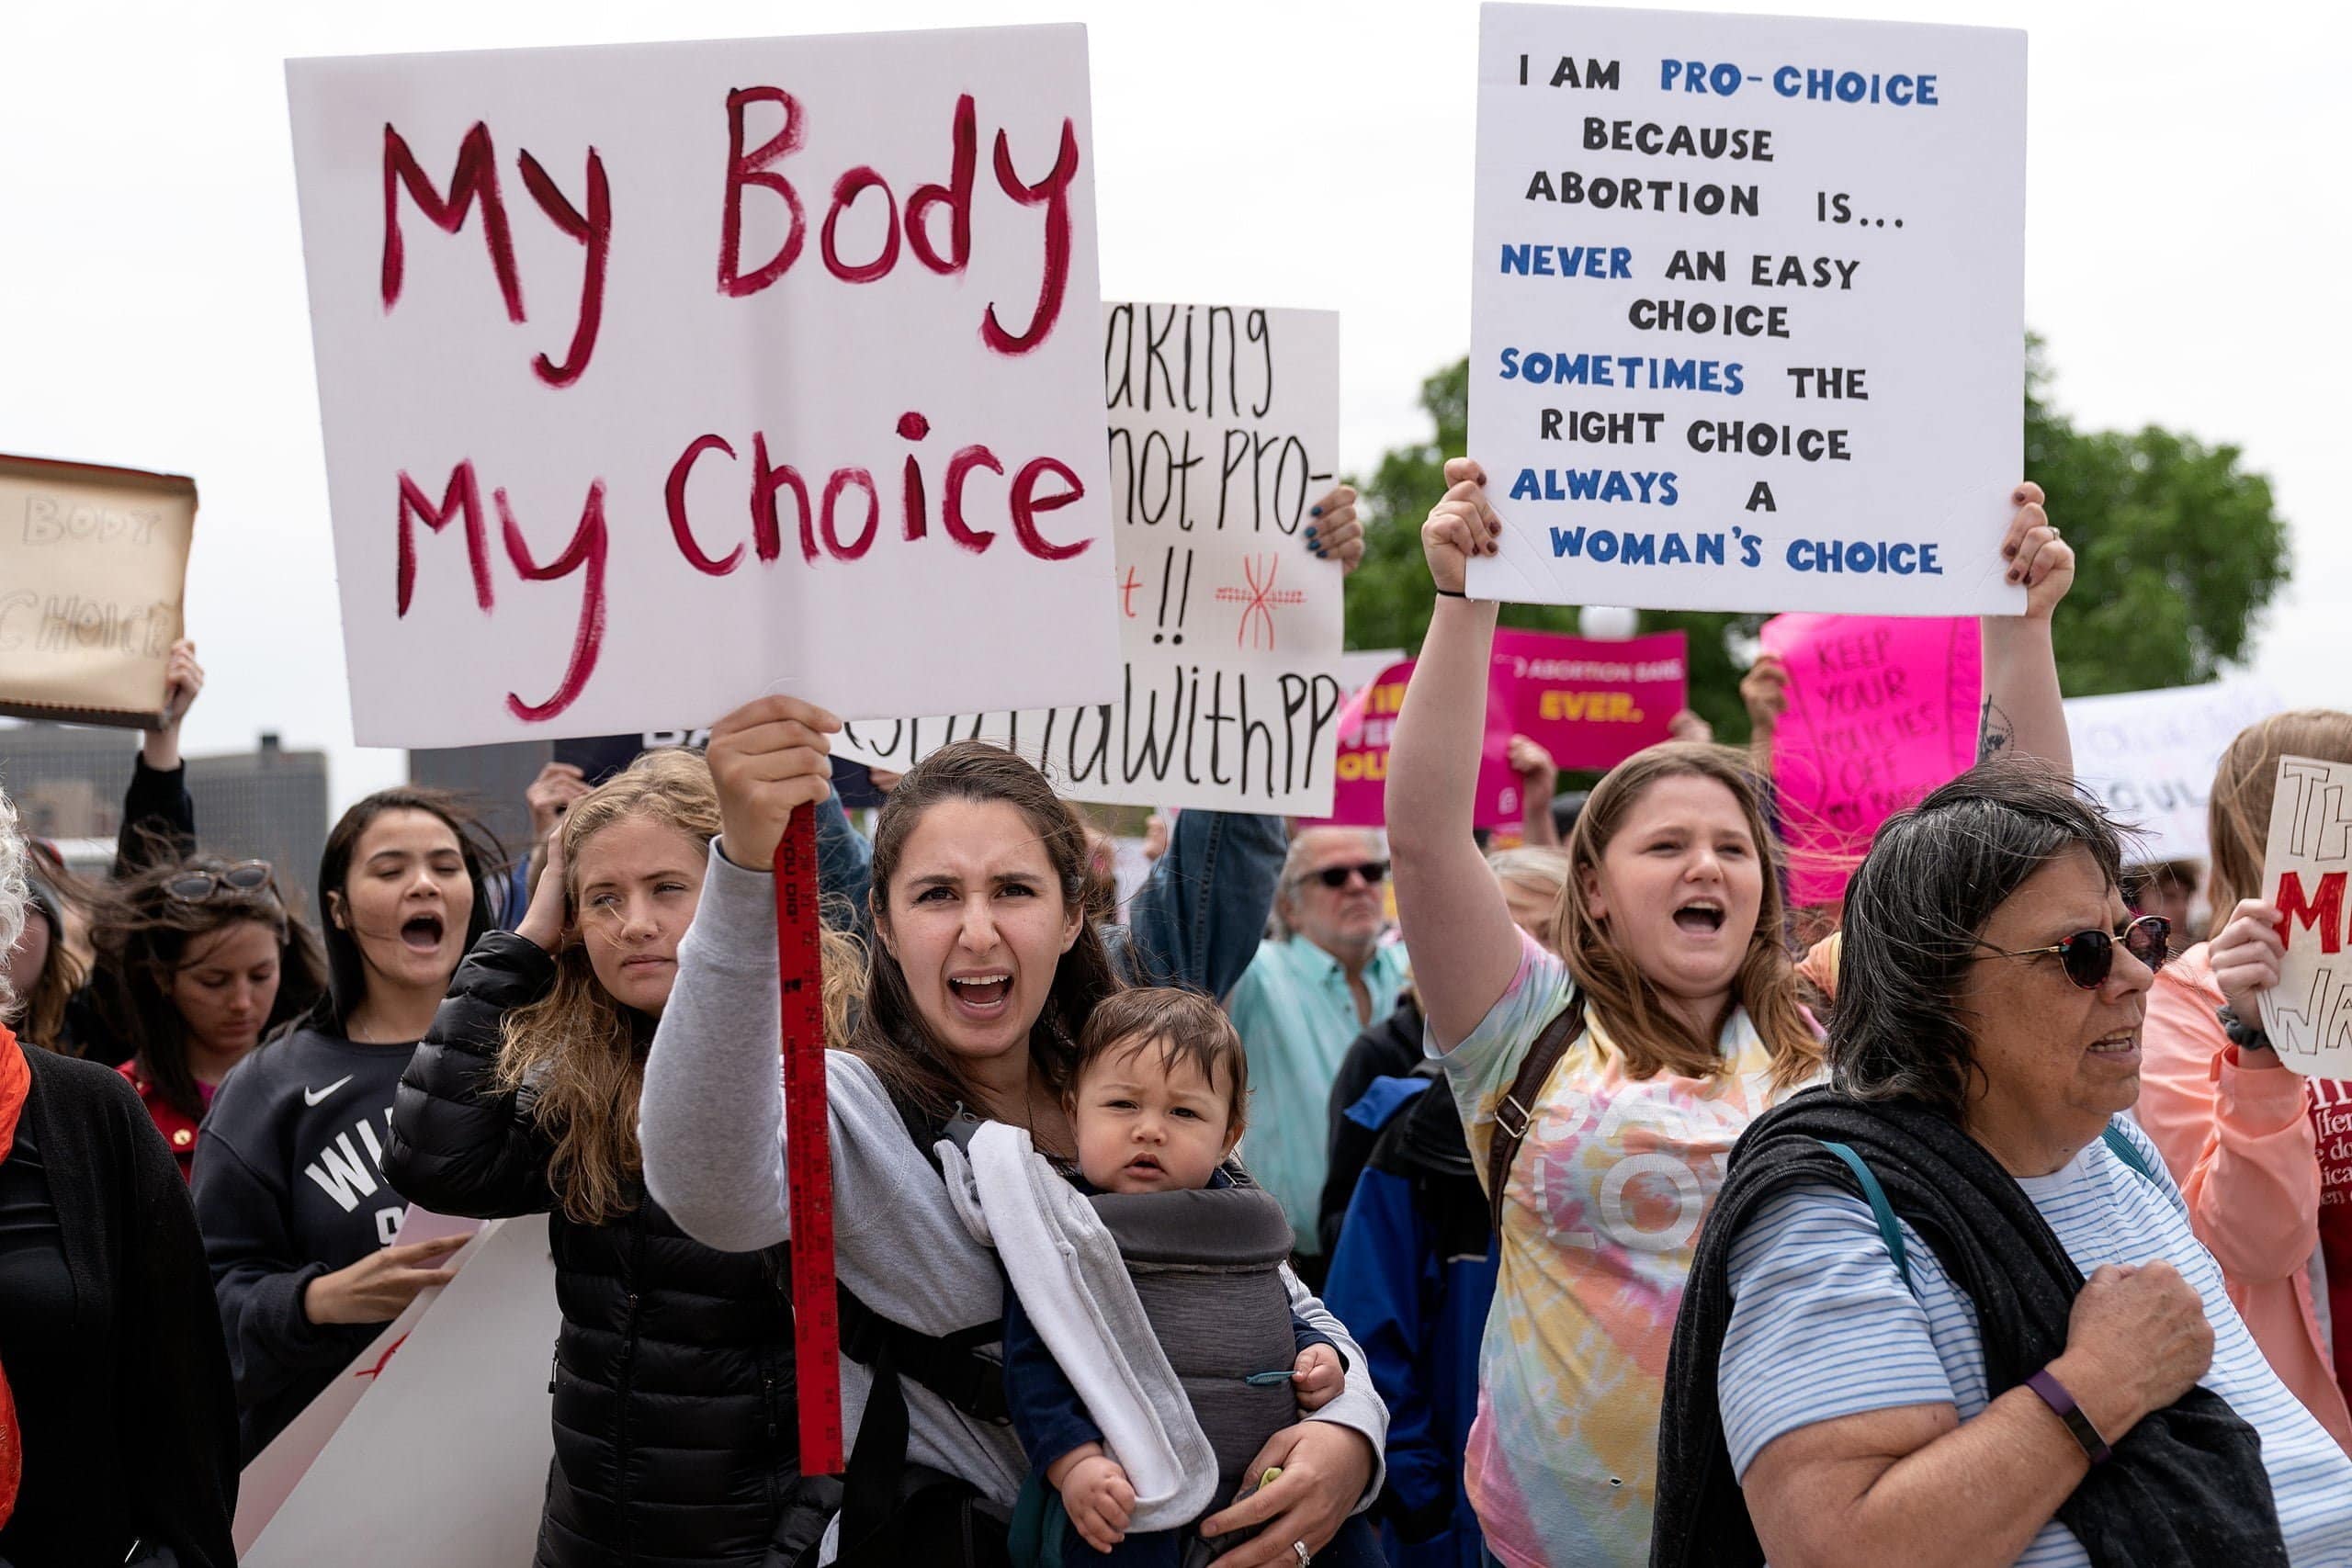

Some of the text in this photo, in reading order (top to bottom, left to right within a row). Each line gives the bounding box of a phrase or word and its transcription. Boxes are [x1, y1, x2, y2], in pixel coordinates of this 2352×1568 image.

[1521, 55, 1939, 106] I AM PRO-CHOICE
[1584, 118, 1774, 162] BECAUSE
[1526, 172, 1904, 229] ABORTION IS...
[379, 85, 1080, 389] My Body
[1501, 244, 1860, 290] NEVER AN EASY
[1629, 299, 1790, 338] CHOICE
[1499, 348, 1869, 400] SOMETIMES THE
[1542, 409, 1851, 461] RIGHT CHOICE
[1510, 469, 1777, 513] ALWAYS A
[395, 411, 1096, 723] My Choice
[1786, 539, 1943, 575] CHOICE
[1539, 690, 1645, 723] EVER.
